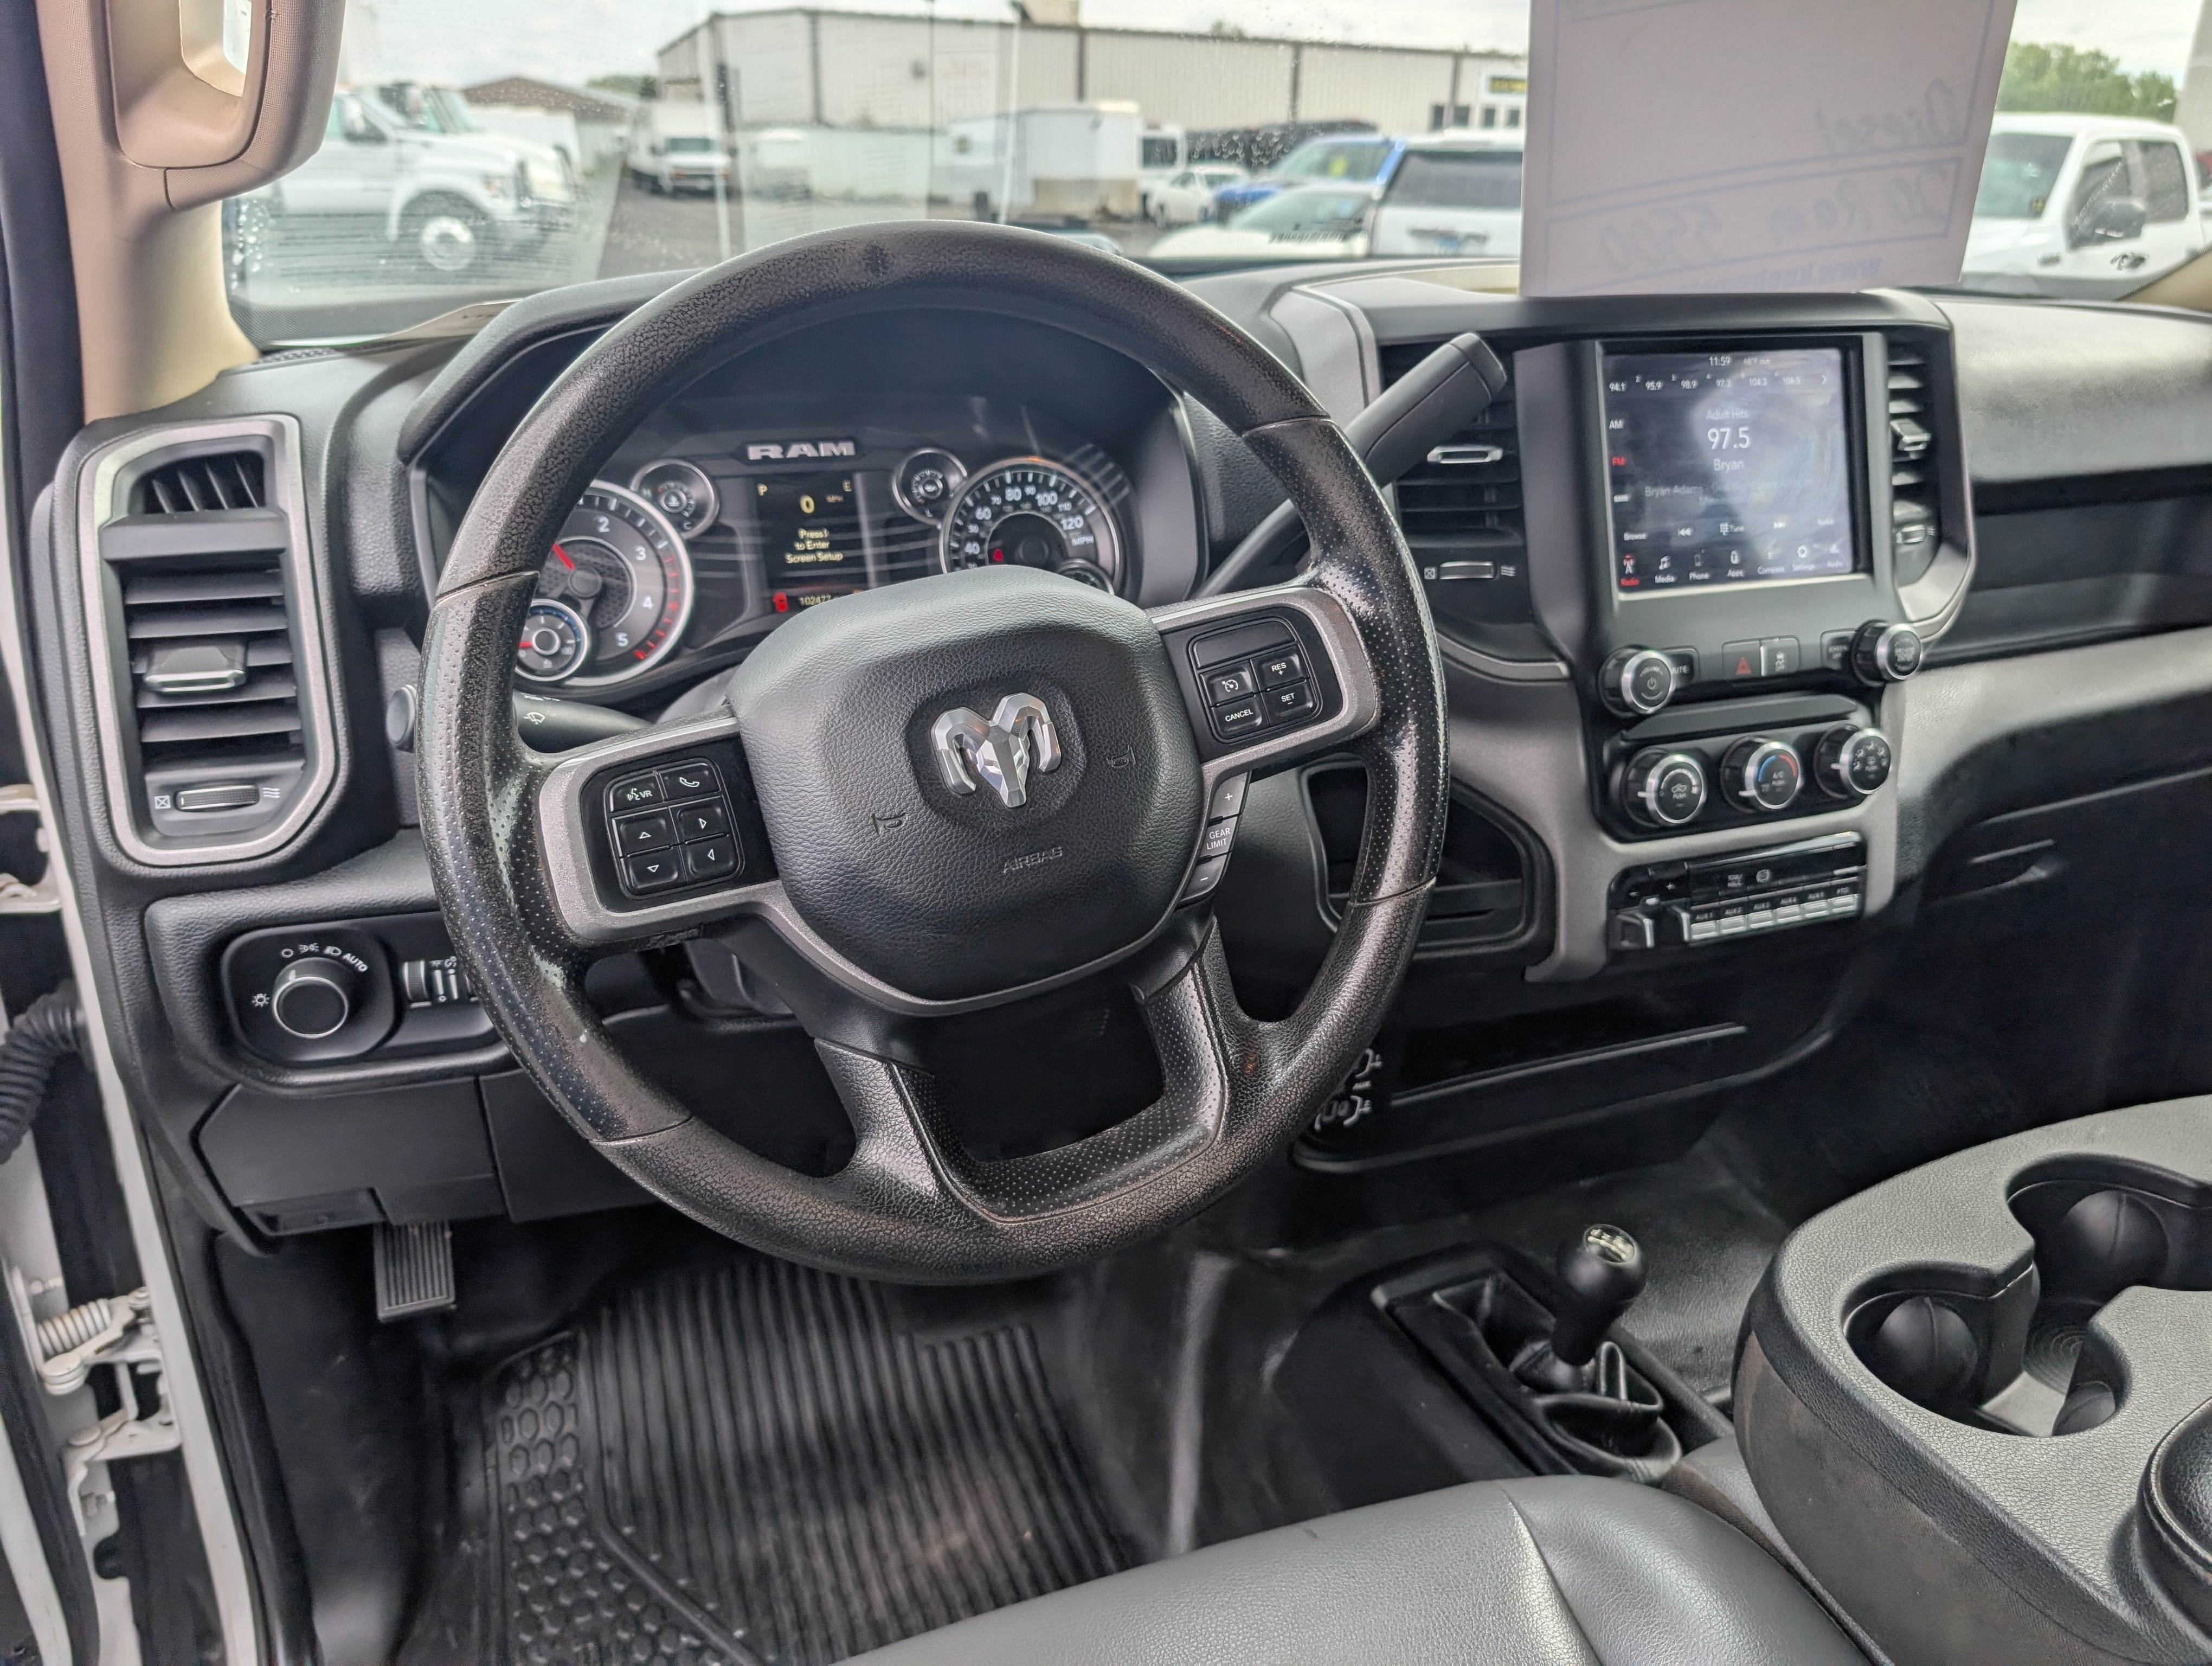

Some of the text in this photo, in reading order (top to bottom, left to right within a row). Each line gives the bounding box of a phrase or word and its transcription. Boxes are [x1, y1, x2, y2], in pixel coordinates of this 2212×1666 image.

[1709, 356, 1732, 367] 11:59
[1609, 419, 1624, 430] AM
[1707, 426, 1751, 450] 97.5
[747, 441, 856, 460] RAM
[1612, 457, 1626, 466] FM
[1713, 459, 1745, 473] Bryan
[757, 482, 768, 496] P
[800, 494, 815, 514] 0
[842, 480, 852, 492] E
[1005, 486, 1023, 502] 80
[1035, 490, 1058, 507] 100
[1645, 486, 1670, 498] Bryan
[991, 494, 1002, 505] 70
[975, 507, 992, 520] 60
[597, 515, 610, 533] 2
[1060, 516, 1084, 531] 120
[794, 539, 829, 551] to Enter
[964, 541, 980, 555] 40
[634, 545, 647, 562] 3
[786, 551, 844, 564] Screen Setup
[641, 595, 654, 610] 4
[614, 632, 629, 648] 5
[1271, 662, 1287, 672] RES
[1281, 693, 1296, 702] SET
[1225, 708, 1253, 722] CANCEL
[640, 790, 653, 799] VR
[1209, 827, 1231, 840] GEAR
[1206, 838, 1227, 850] LIMIT
[1001, 844, 1064, 875] AIRBAG
[342, 953, 368, 972] AUTO
